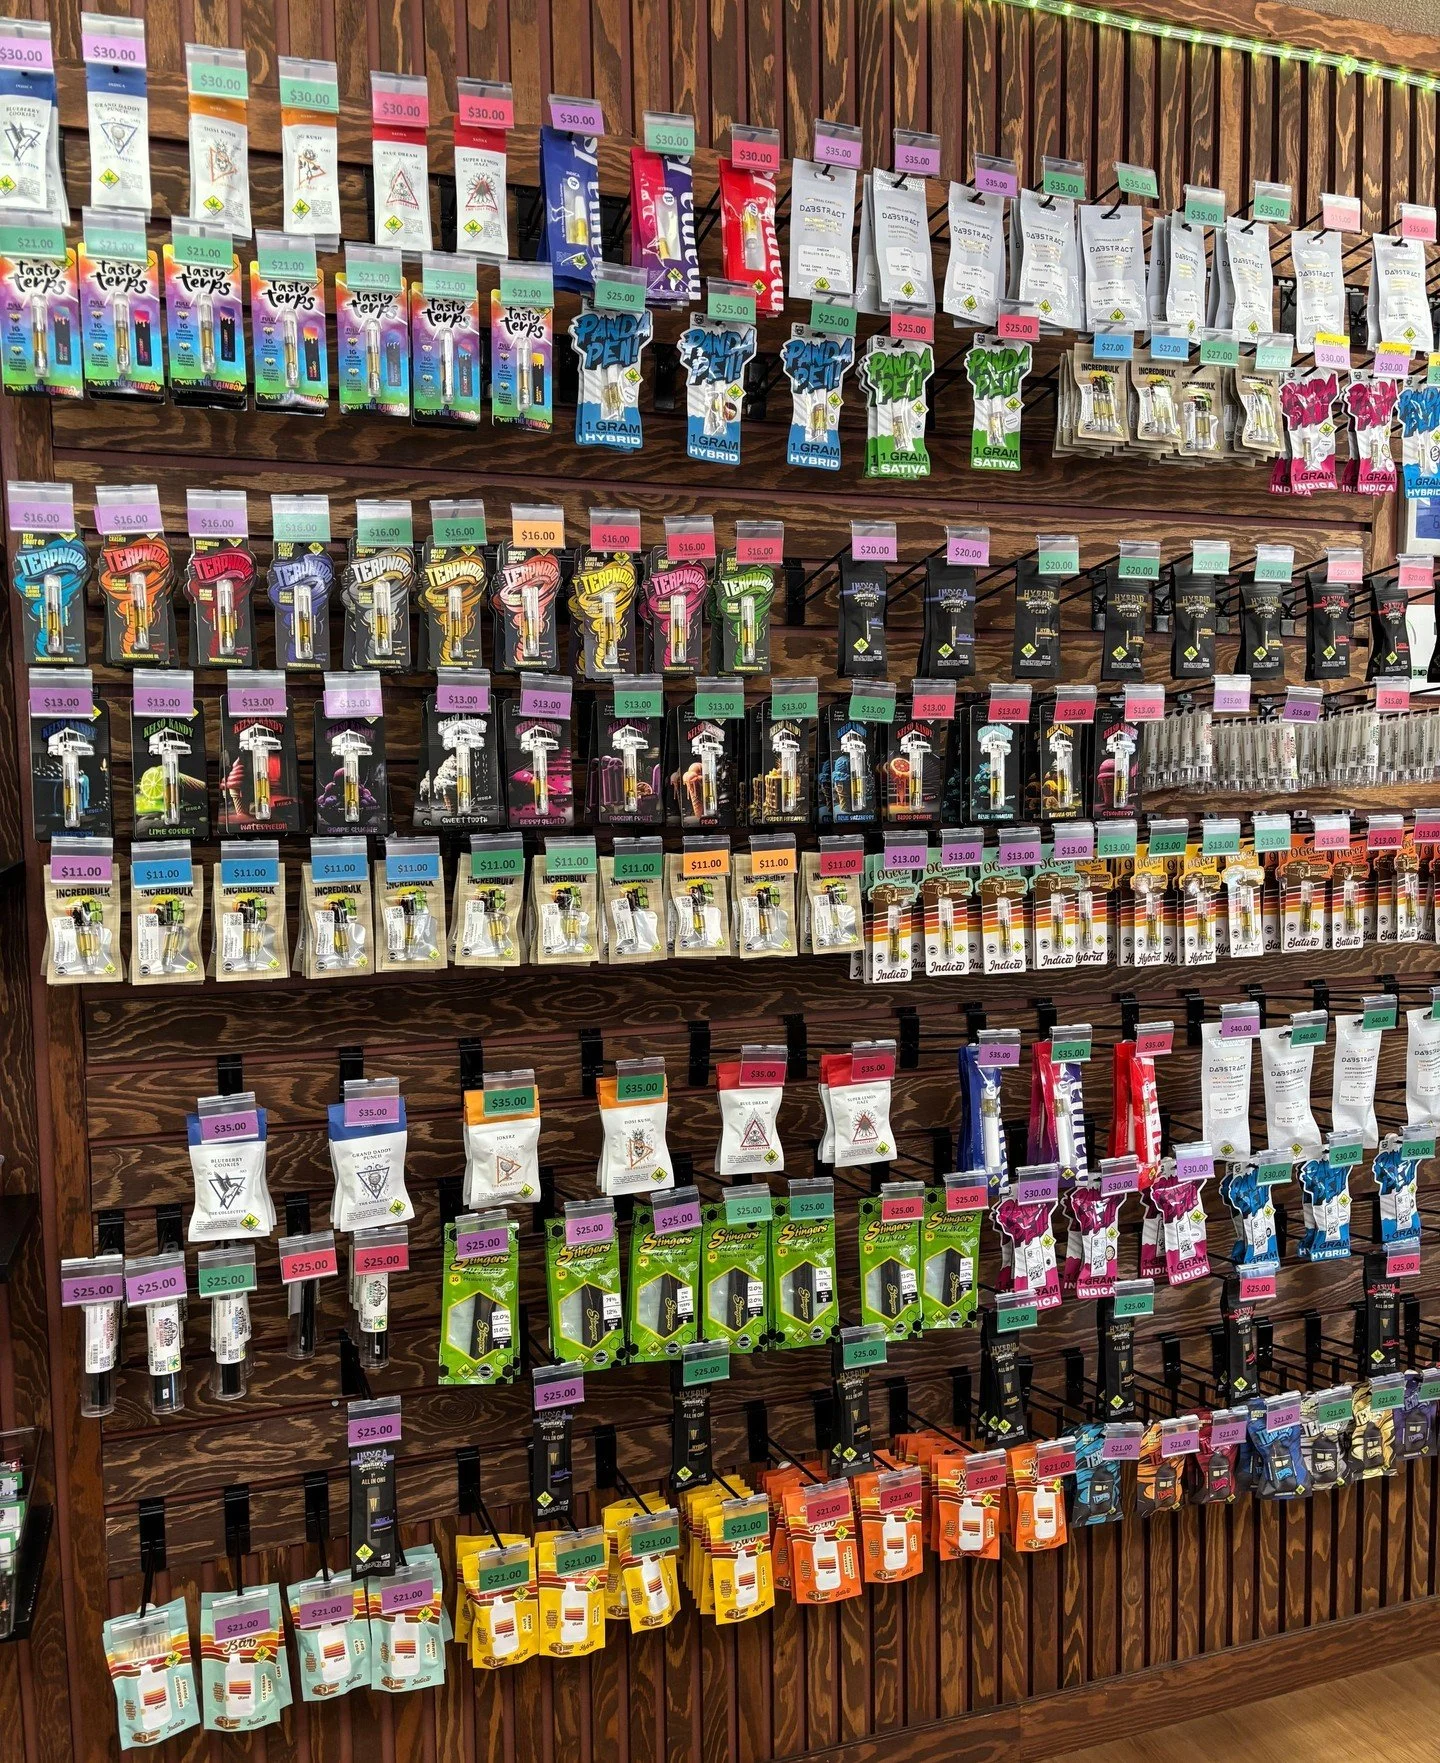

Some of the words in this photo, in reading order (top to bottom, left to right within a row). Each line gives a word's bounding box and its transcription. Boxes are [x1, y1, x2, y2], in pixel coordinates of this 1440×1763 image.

[93, 45, 136, 62] $30.00
[200, 74, 241, 91] $30.00
[290, 88, 330, 106] $30.00
[382, 101, 421, 118] $30.00
[468, 106, 505, 121] $30.00
[560, 112, 595, 127] $30.00
[655, 133, 689, 148] $30.00
[739, 148, 772, 164] $30.00
[825, 145, 852, 159] $35.00
[905, 154, 930, 166] $35.00
[985, 177, 1008, 190] $35.00
[1050, 180, 1078, 194] $35.00
[1125, 178, 1151, 192] $35.00
[799, 203, 847, 219] DABSTRACT
[1260, 204, 1285, 217] $35.00
[881, 211, 920, 228] DABSTRACT
[953, 224, 994, 242] DABSTRACT
[187, 246, 221, 259] $21.00
[1089, 245, 1135, 254] DABSTRACT
[97, 260, 141, 279] tasty
[9, 274, 67, 296] terps
[89, 273, 147, 295] terps
[177, 274, 231, 296] terps
[261, 287, 316, 310] terps
[512, 288, 542, 299] $21.00
[606, 290, 635, 303] $25.00
[430, 297, 466, 315] tasty
[716, 303, 749, 316] $25.00
[507, 308, 540, 323] tasty
[818, 312, 850, 327] $25.00
[500, 317, 545, 339] terps
[897, 322, 926, 335] $25.00
[1005, 322, 1033, 335] $25.00
[1101, 340, 1125, 352] $27.00
[1159, 343, 1181, 354] $27.00
[1206, 350, 1233, 361] $27.00
[1321, 353, 1346, 364] $30.00
[1081, 363, 1120, 375] INCREDIBULK
[1138, 366, 1176, 378] INCREDIBULK
[1380, 361, 1404, 372] $30.00
[586, 434, 641, 446] HYBRID
[689, 445, 739, 461] HYBRID
[790, 454, 840, 469] HYBRID
[972, 458, 1019, 470] SATIVA
[879, 463, 928, 475] SATIVA
[1293, 481, 1336, 491] INDICA
[1358, 484, 1395, 493] INDICA
[23, 511, 60, 524] $16.00
[114, 514, 149, 525] $16.00
[201, 518, 235, 529] $16.00
[369, 527, 400, 538] $16.00
[445, 527, 475, 538] $16.00
[521, 531, 556, 541] $16.00
[678, 542, 706, 553] $16.00
[747, 547, 774, 556] $16.00
[860, 545, 890, 556] $20.00
[955, 548, 982, 559] $20.00
[16, 546, 87, 576] TERPNADO
[103, 544, 170, 573] TERPNADO
[1045, 560, 1073, 570] $20.00
[190, 553, 254, 581] TERPNADO
[350, 555, 411, 583] TERPNADO
[424, 559, 485, 587] TERPNADO
[1126, 566, 1154, 576] $20.00
[502, 560, 559, 588] TERPNADO
[580, 565, 635, 596] TERPNADO
[651, 568, 706, 597] TERPNADO
[721, 572, 774, 598] TERPNADO
[1024, 589, 1055, 600] HYBRID
[1321, 595, 1345, 605] SATIVA
[242, 697, 275, 708] $13.00
[143, 719, 166, 738] KELSO
[168, 719, 194, 738] KANDY
[896, 723, 913, 739] KELSO
[914, 723, 933, 738] KANDY
[240, 822, 288, 832] WATERMELON
[1103, 842, 1131, 853] $13.00
[1208, 840, 1234, 850] $13.00
[1260, 836, 1286, 846] $13.00
[948, 850, 975, 861] $13.00
[1006, 850, 1035, 861] $13.00
[1061, 844, 1088, 855] $13.00
[480, 859, 516, 871] $11.00
[555, 857, 589, 868] $11.00
[691, 858, 722, 870] $11.00
[759, 857, 789, 869] $11.00
[827, 859, 857, 870] $11.00
[892, 853, 920, 864] $13.00
[61, 866, 102, 878] $11.00
[146, 868, 180, 880] $11.00
[233, 867, 267, 878] $11.00
[324, 863, 356, 874] $11.00
[397, 863, 428, 873] $11.00
[621, 862, 655, 874] $11.00
[542, 874, 587, 885] INCREDIBULK
[56, 888, 110, 898] INCREDIBULK
[141, 887, 194, 898] INCREDIBULK
[314, 885, 362, 896] INCREDIBULK
[1287, 936, 1320, 948] Sativa
[1335, 936, 1361, 948] Sativa
[1042, 953, 1074, 967] Indica
[1137, 951, 1162, 965] Hybrid
[1188, 949, 1213, 964] Hybrid
[929, 960, 965, 974] Indica
[988, 958, 1023, 972] Indica
[875, 967, 909, 983] Indica
[1058, 1048, 1085, 1060] $35.00
[861, 1063, 886, 1074] $35.00
[1209, 1064, 1247, 1073] DABSTRACT
[1270, 1066, 1308, 1078] DABSTRACT
[625, 1082, 658, 1094] $35.00
[491, 1096, 527, 1108] $35.00
[358, 1107, 388, 1118] $35.00
[214, 1122, 247, 1134] $35.00
[351, 1152, 371, 1160] GRAND
[372, 1148, 392, 1157] DADDY
[210, 1157, 243, 1165] BLUEBERRY
[1024, 1187, 1051, 1199] $30.00
[890, 1205, 914, 1216] $25.00
[661, 1212, 693, 1228] $25.00
[925, 1210, 976, 1230] Stingers
[575, 1223, 604, 1236] $25.00
[777, 1222, 829, 1244] Stingers
[863, 1220, 912, 1241] Stingers
[465, 1237, 501, 1251] $25.00
[638, 1232, 694, 1253] Stingers
[707, 1228, 761, 1249] Stingers
[1312, 1248, 1349, 1258] HYBRID
[291, 1260, 328, 1275] $25.00
[363, 1255, 400, 1268] $25.00
[207, 1274, 245, 1286] $25.00
[1171, 1266, 1209, 1283] INDICA
[73, 1284, 114, 1298] $25.00
[137, 1277, 177, 1295] $25.00
[1078, 1287, 1116, 1297] INDICA
[543, 1387, 577, 1402] $25.00
[357, 1424, 393, 1439] $25.00
[357, 1449, 388, 1462] INDICA
[1044, 1461, 1071, 1474] $21.00
[816, 1504, 841, 1516] $21.00
[731, 1520, 762, 1535] $21.00
[639, 1536, 672, 1551] $21.00
[564, 1554, 597, 1570] $21.00
[487, 1569, 522, 1585] $21.00
[393, 1589, 423, 1603] $21.00
[311, 1605, 342, 1617] $21.00
[227, 1618, 259, 1633] $21.00
[223, 1637, 258, 1654] Bar
